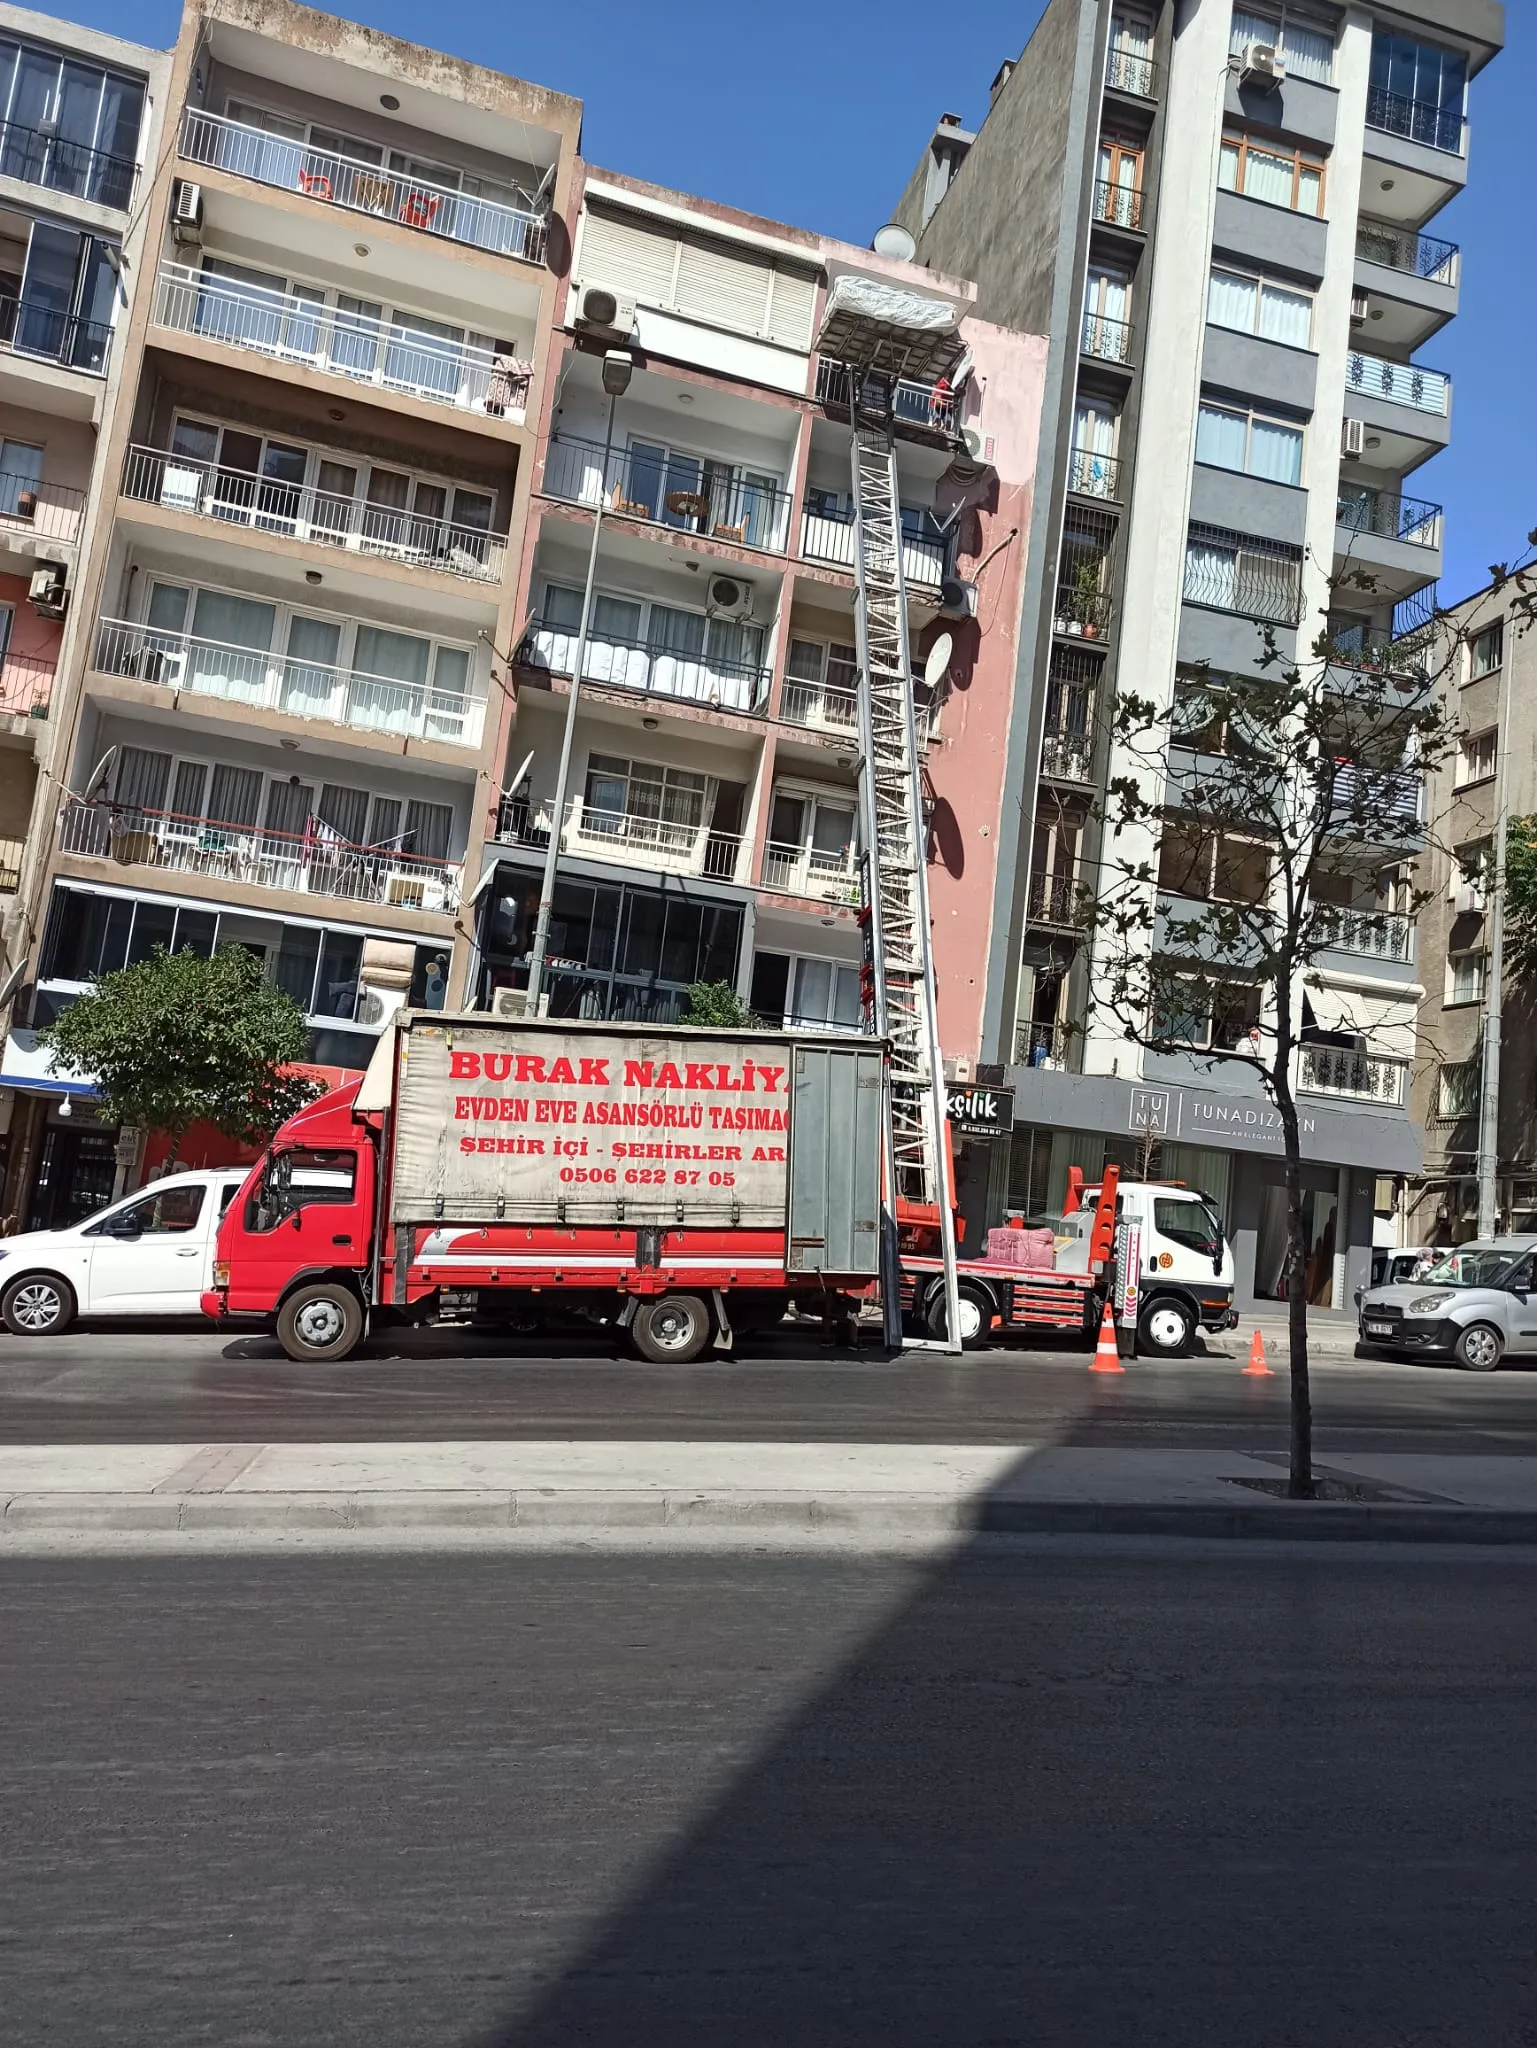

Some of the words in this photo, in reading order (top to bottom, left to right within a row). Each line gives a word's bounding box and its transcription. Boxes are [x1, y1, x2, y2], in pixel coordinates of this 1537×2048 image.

[449, 1051, 610, 1085] BURAK
[455, 1096, 529, 1122] EVDEN
[535, 1100, 577, 1124] EVE
[582, 1100, 703, 1128] ASANSÖRLÜ
[1138, 1095, 1162, 1111] TU
[1136, 1112, 1160, 1127] NA
[1192, 1103, 1315, 1133] TUNADIZAN
[460, 1135, 545, 1157] ŞEHİR
[553, 1136, 588, 1160] İÇİ
[612, 1140, 742, 1162] ŞEHİRLER
[752, 1147, 787, 1161] AR
[559, 1167, 617, 1183] 0506
[625, 1168, 666, 1184] 622
[674, 1170, 701, 1185] 87
[708, 1171, 736, 1186] 05
